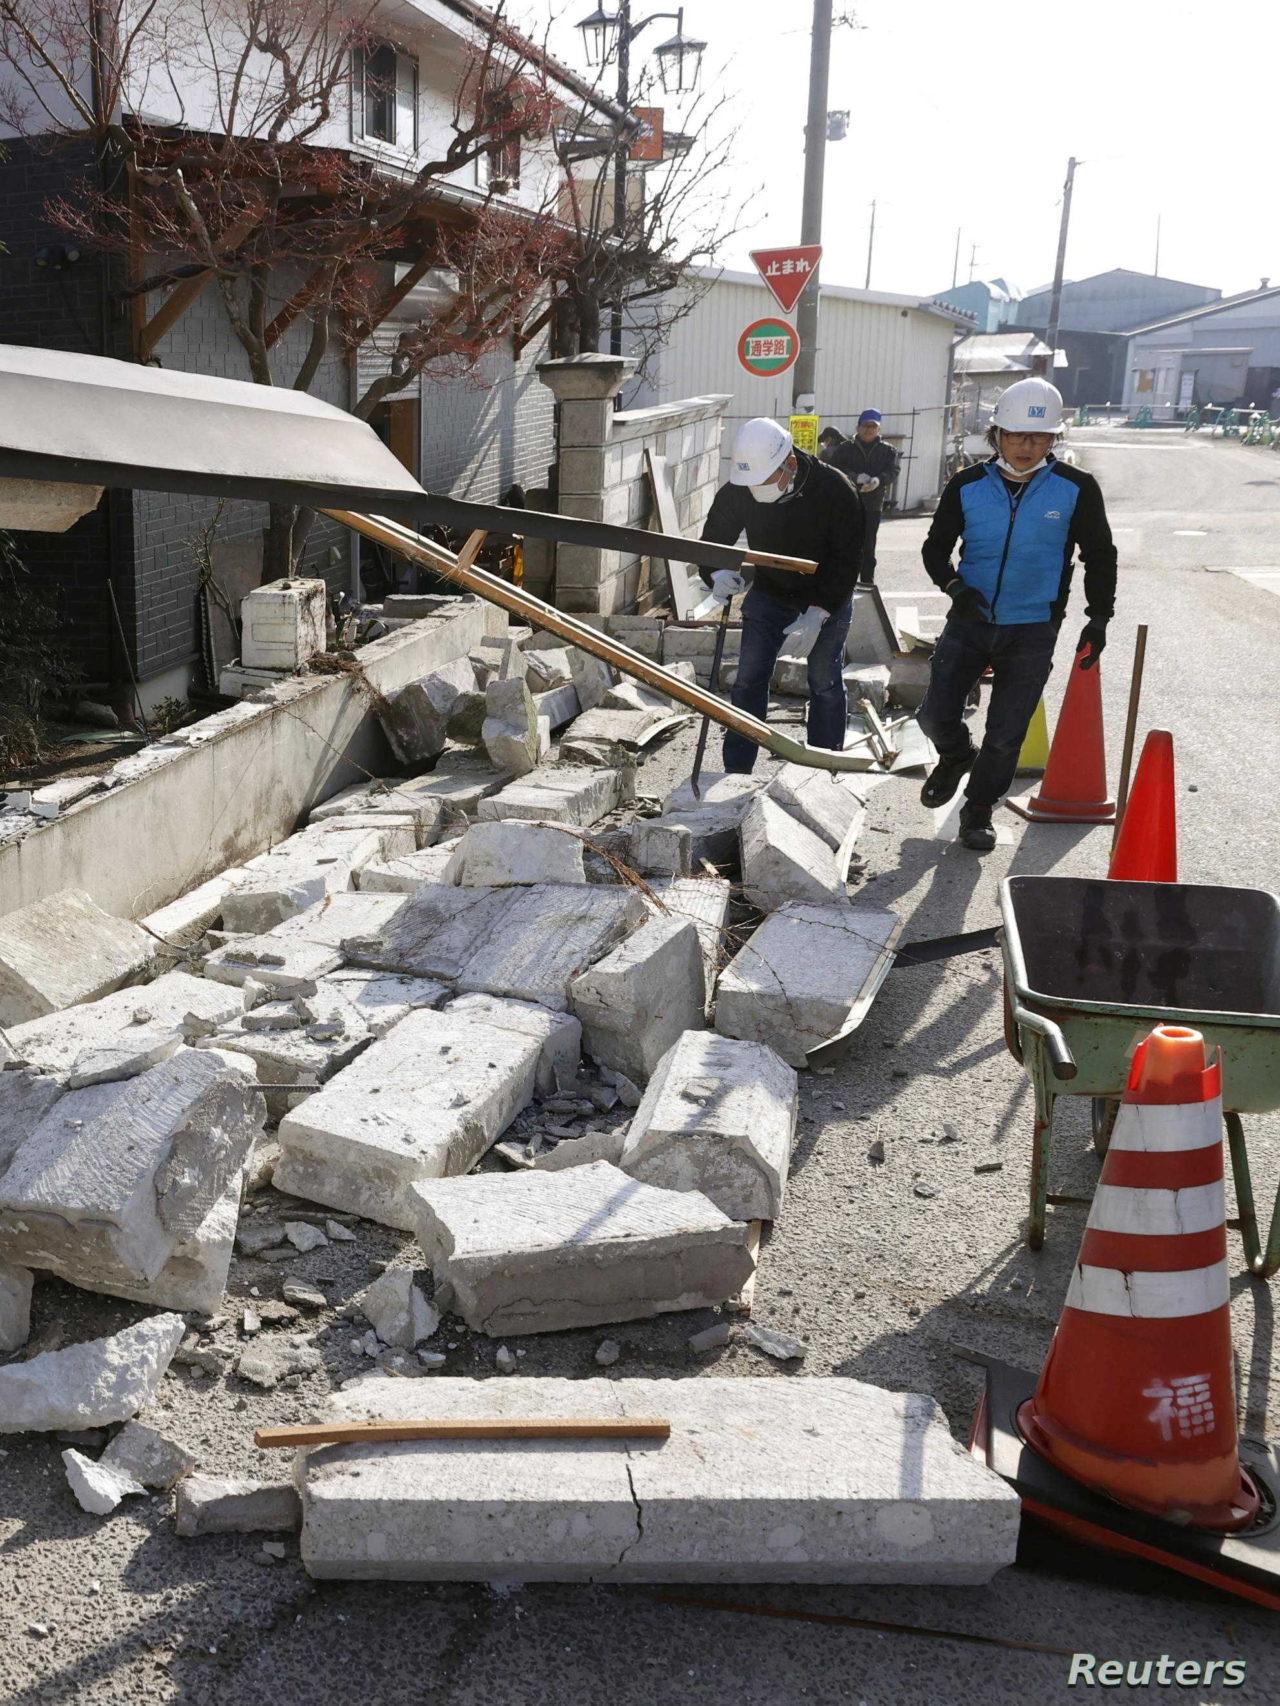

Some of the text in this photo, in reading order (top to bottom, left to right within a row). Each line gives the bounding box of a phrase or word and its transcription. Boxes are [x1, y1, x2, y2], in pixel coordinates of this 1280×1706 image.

[766, 258, 811, 277] 止まれ
[750, 339, 785, 357] 通学路
